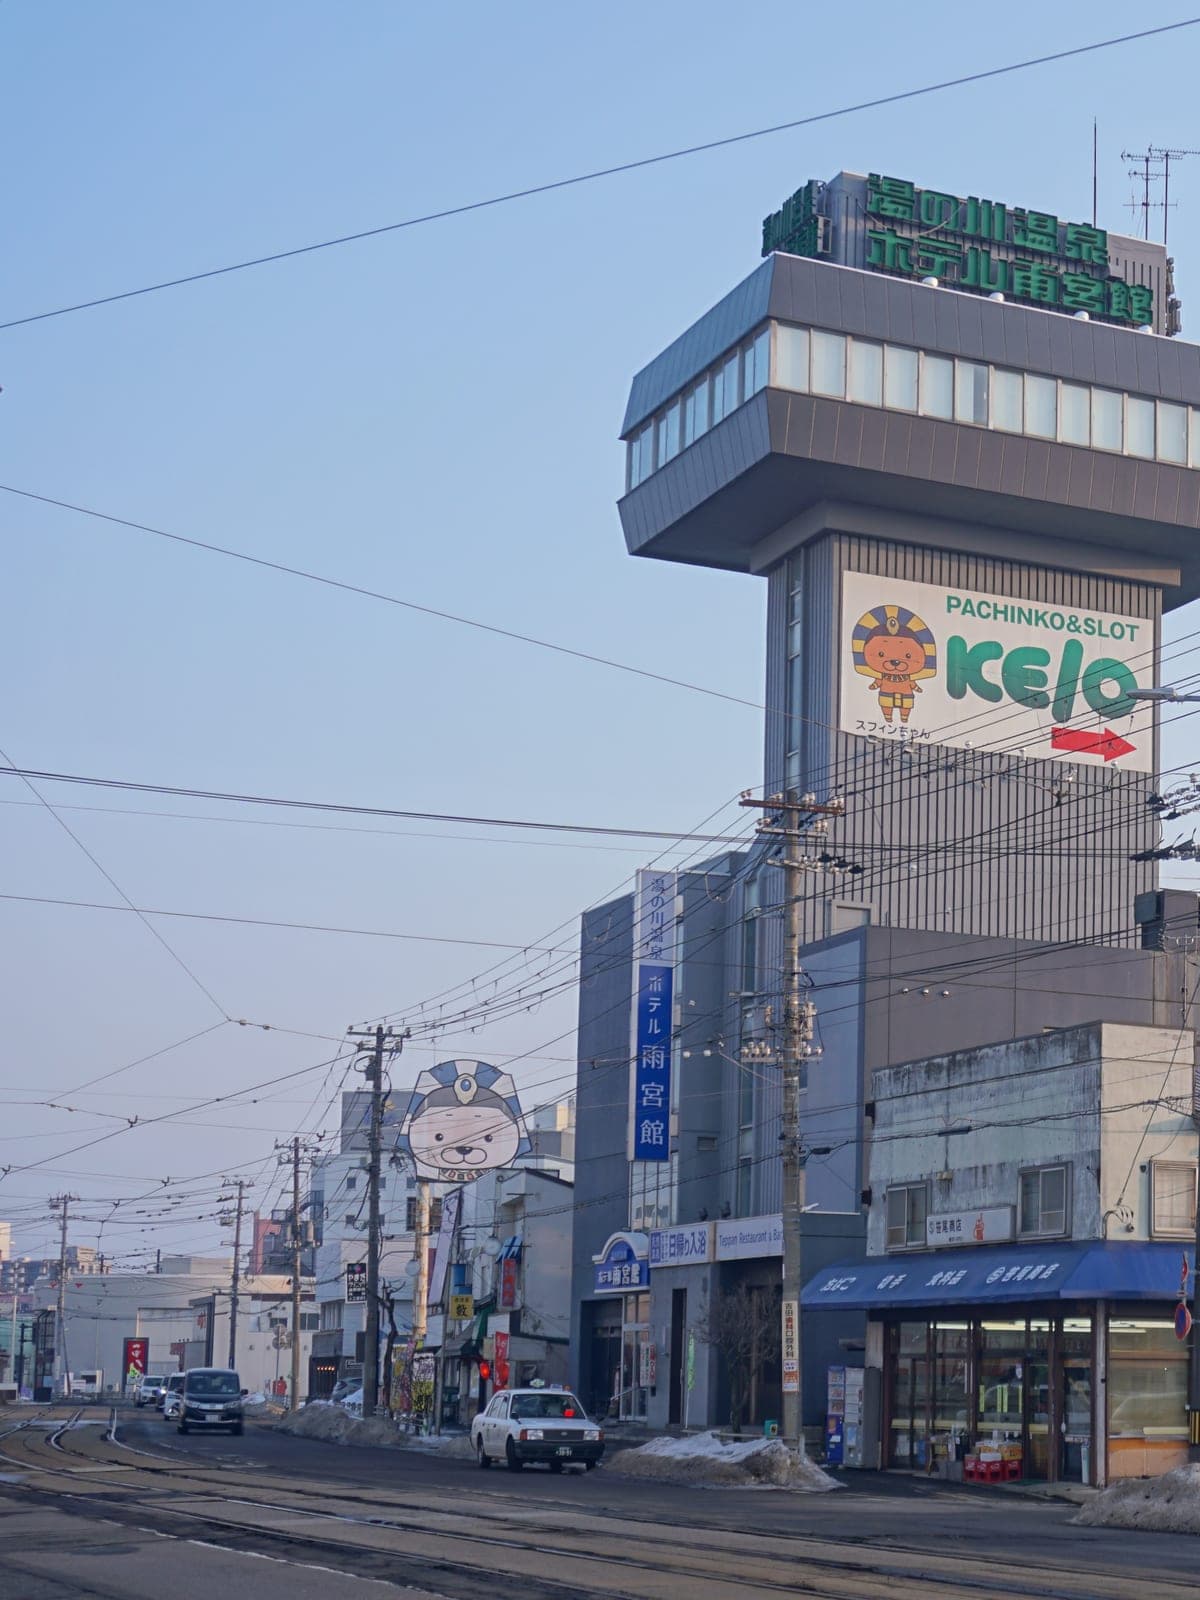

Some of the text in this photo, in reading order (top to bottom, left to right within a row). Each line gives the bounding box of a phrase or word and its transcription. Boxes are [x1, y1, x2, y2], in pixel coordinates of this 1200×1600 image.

[867, 172, 1109, 266] 湯の川温泉
[866, 227, 1154, 325] ホテル雨宮館
[946, 594, 1140, 642] PACHINKO&SLOT
[640, 974, 666, 1147] ホテル雨宮館
[668, 1230, 707, 1259] 日帰り入浴
